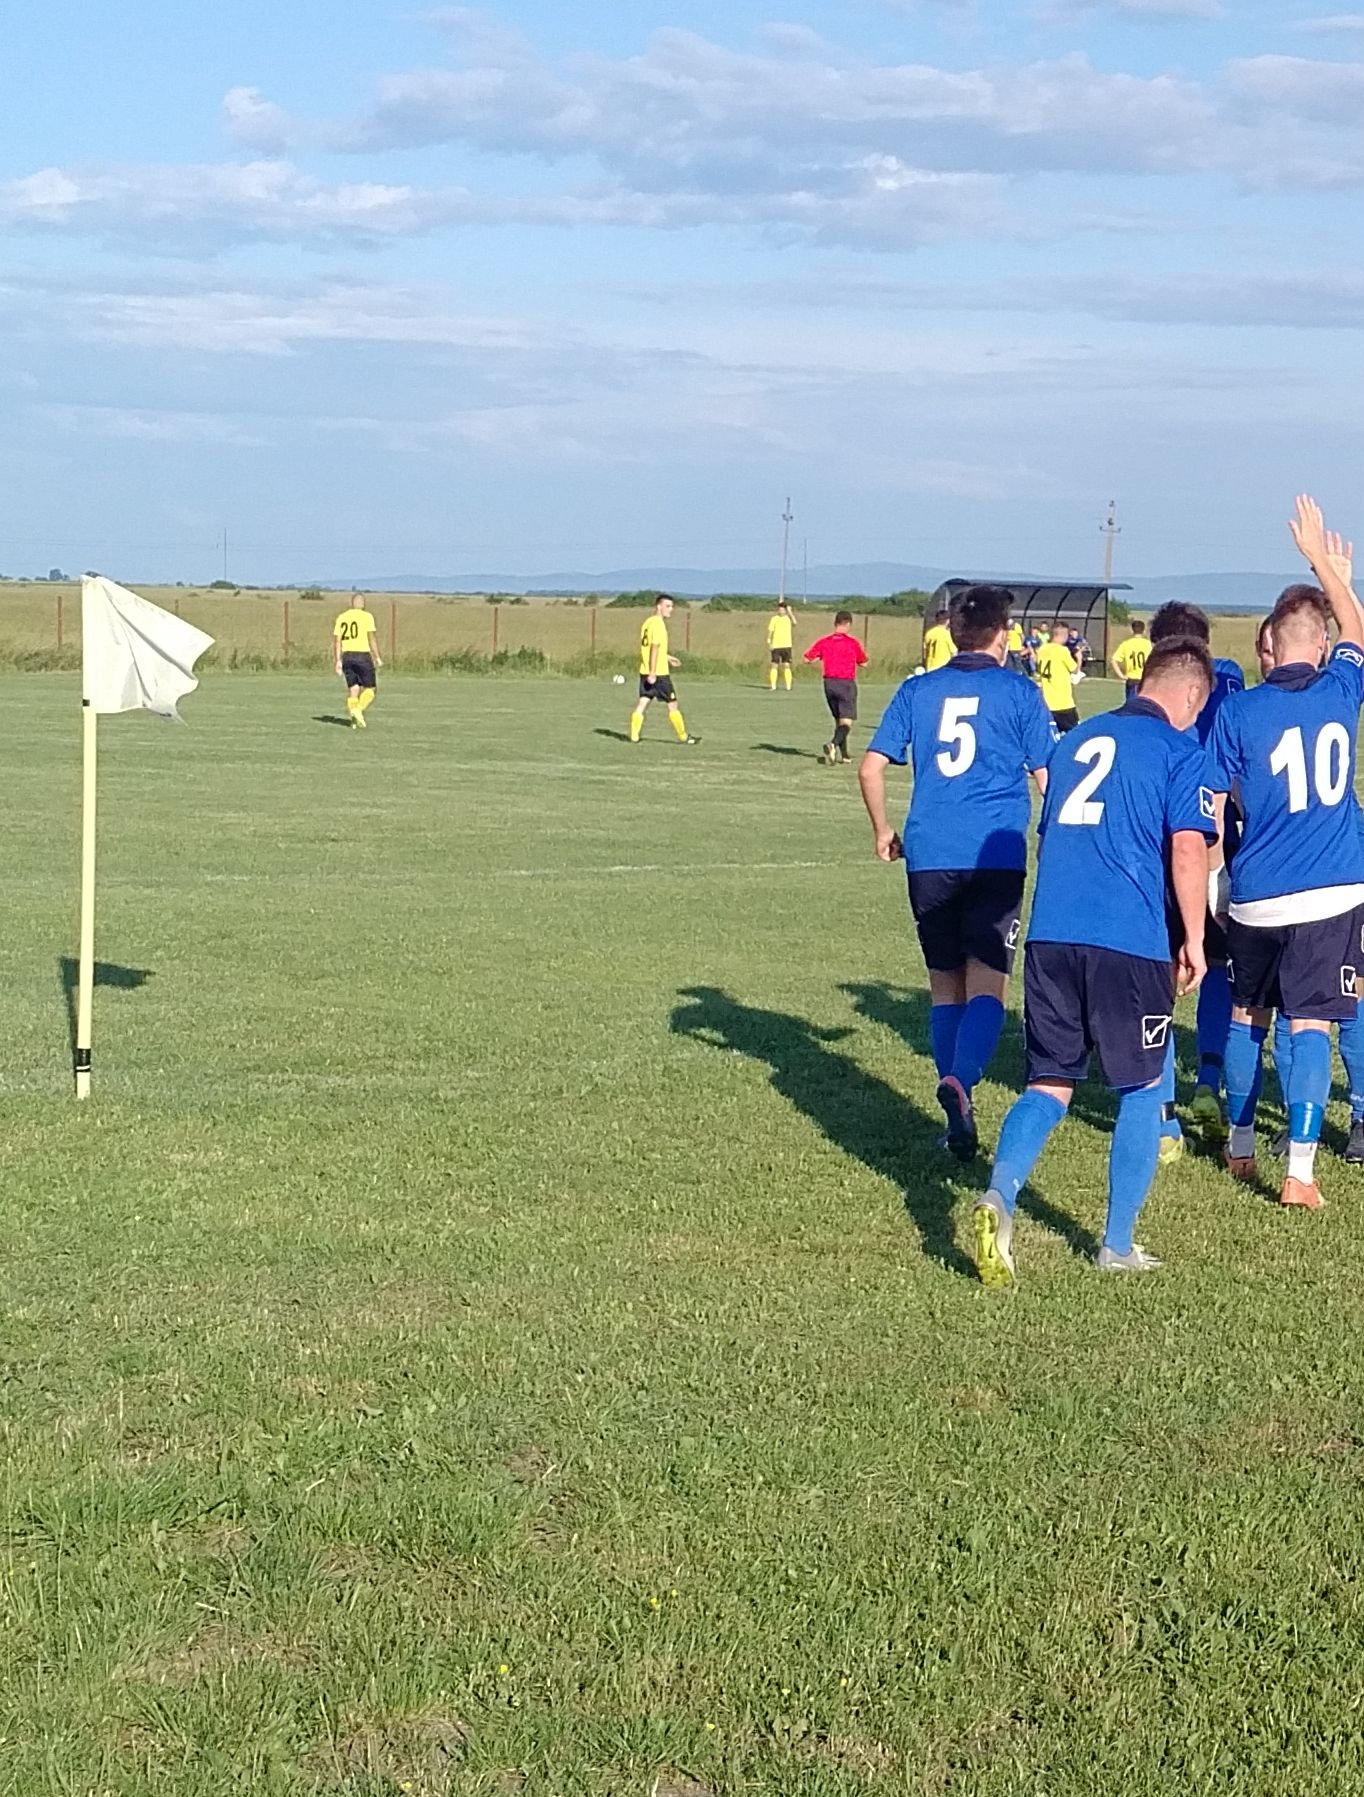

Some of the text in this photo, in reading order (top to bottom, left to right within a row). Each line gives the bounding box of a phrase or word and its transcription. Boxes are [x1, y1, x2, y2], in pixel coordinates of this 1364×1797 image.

[341, 621, 358, 640] 20
[1129, 651, 1145, 670] 10
[937, 697, 979, 777] 5
[1270, 722, 1350, 813] 10
[1058, 736, 1116, 825] 2
